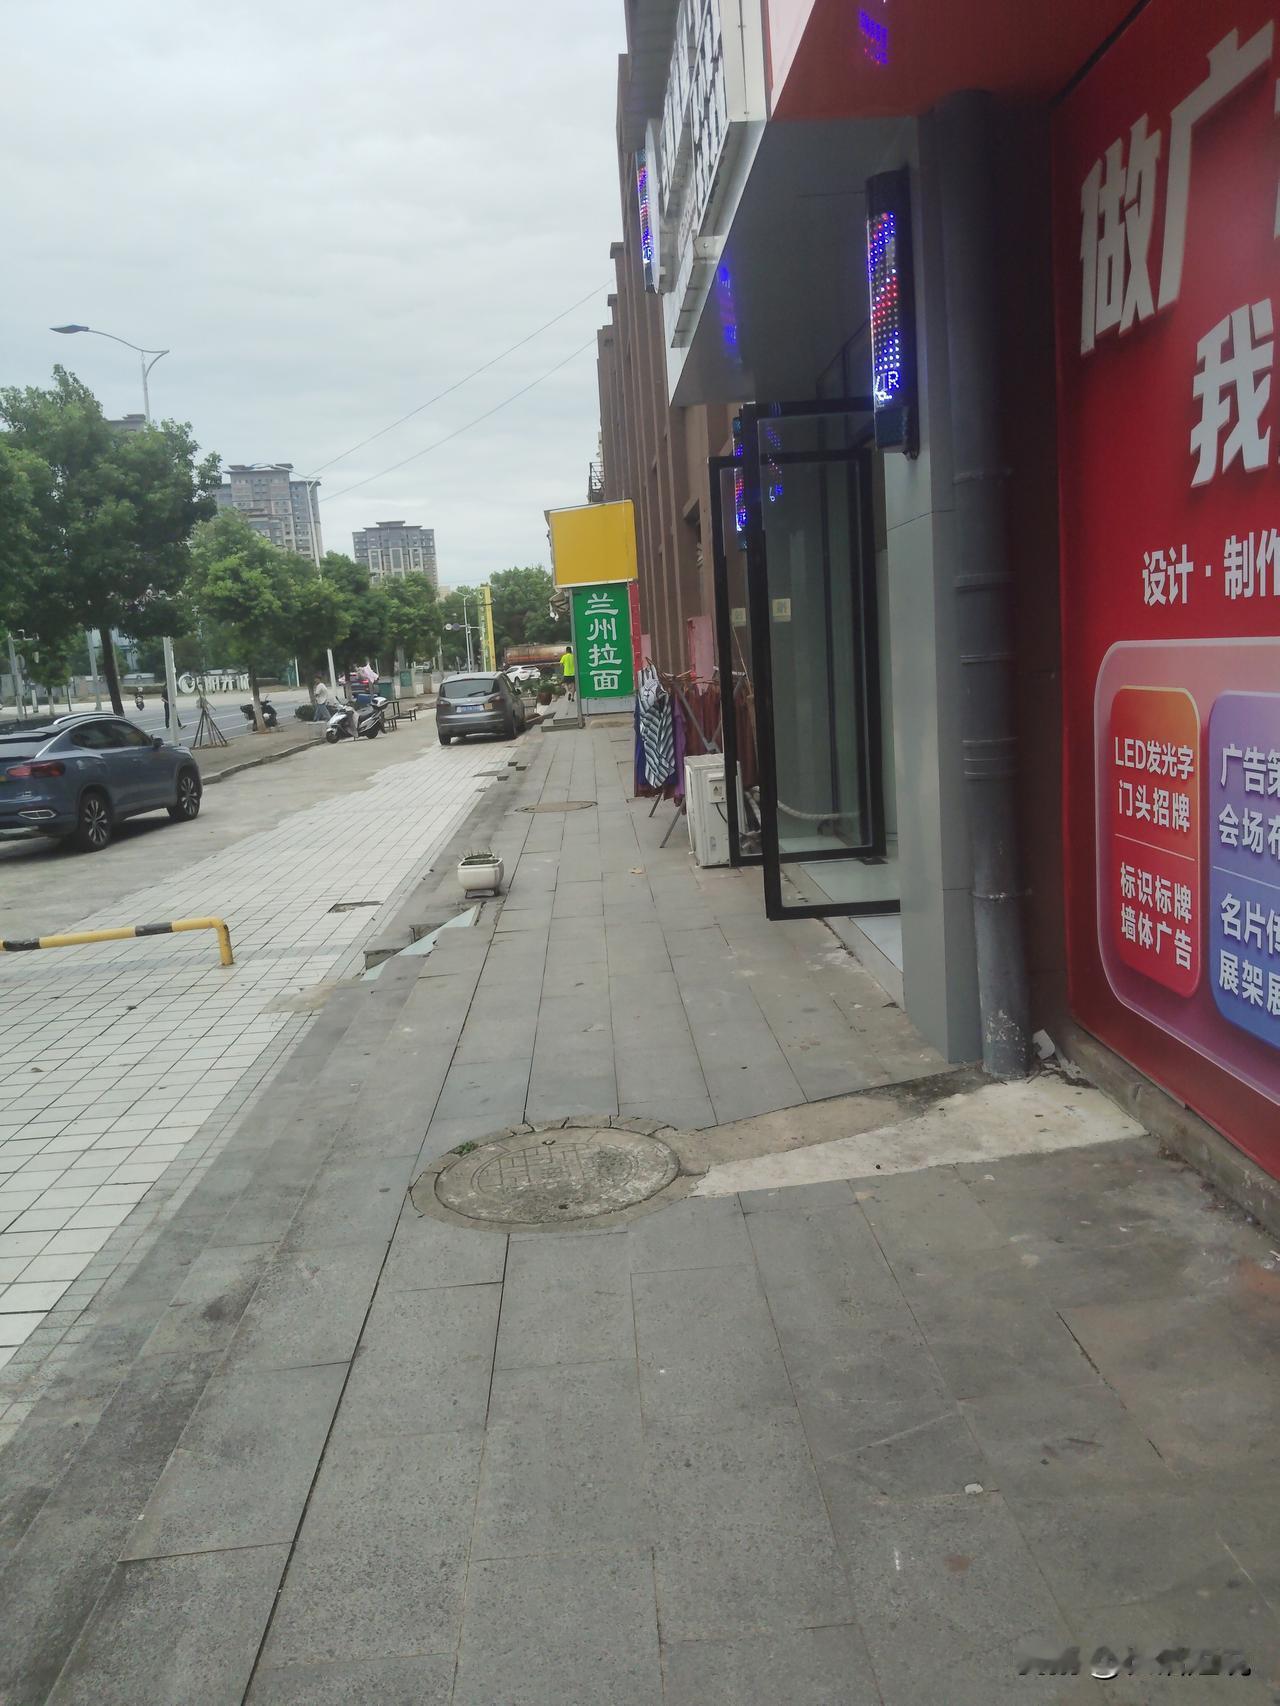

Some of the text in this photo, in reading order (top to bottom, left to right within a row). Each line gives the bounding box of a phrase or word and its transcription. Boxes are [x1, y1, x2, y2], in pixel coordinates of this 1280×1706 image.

[1079, 19, 1280, 357] 做广
[1190, 298, 1280, 489] 我
[584, 592, 622, 691] 兰州拉面
[1114, 736, 1194, 780] LED发光字
[1118, 780, 1191, 833] 门头招牌
[1120, 862, 1192, 924] 标识标牌
[1120, 903, 1193, 970] 墙体广告
